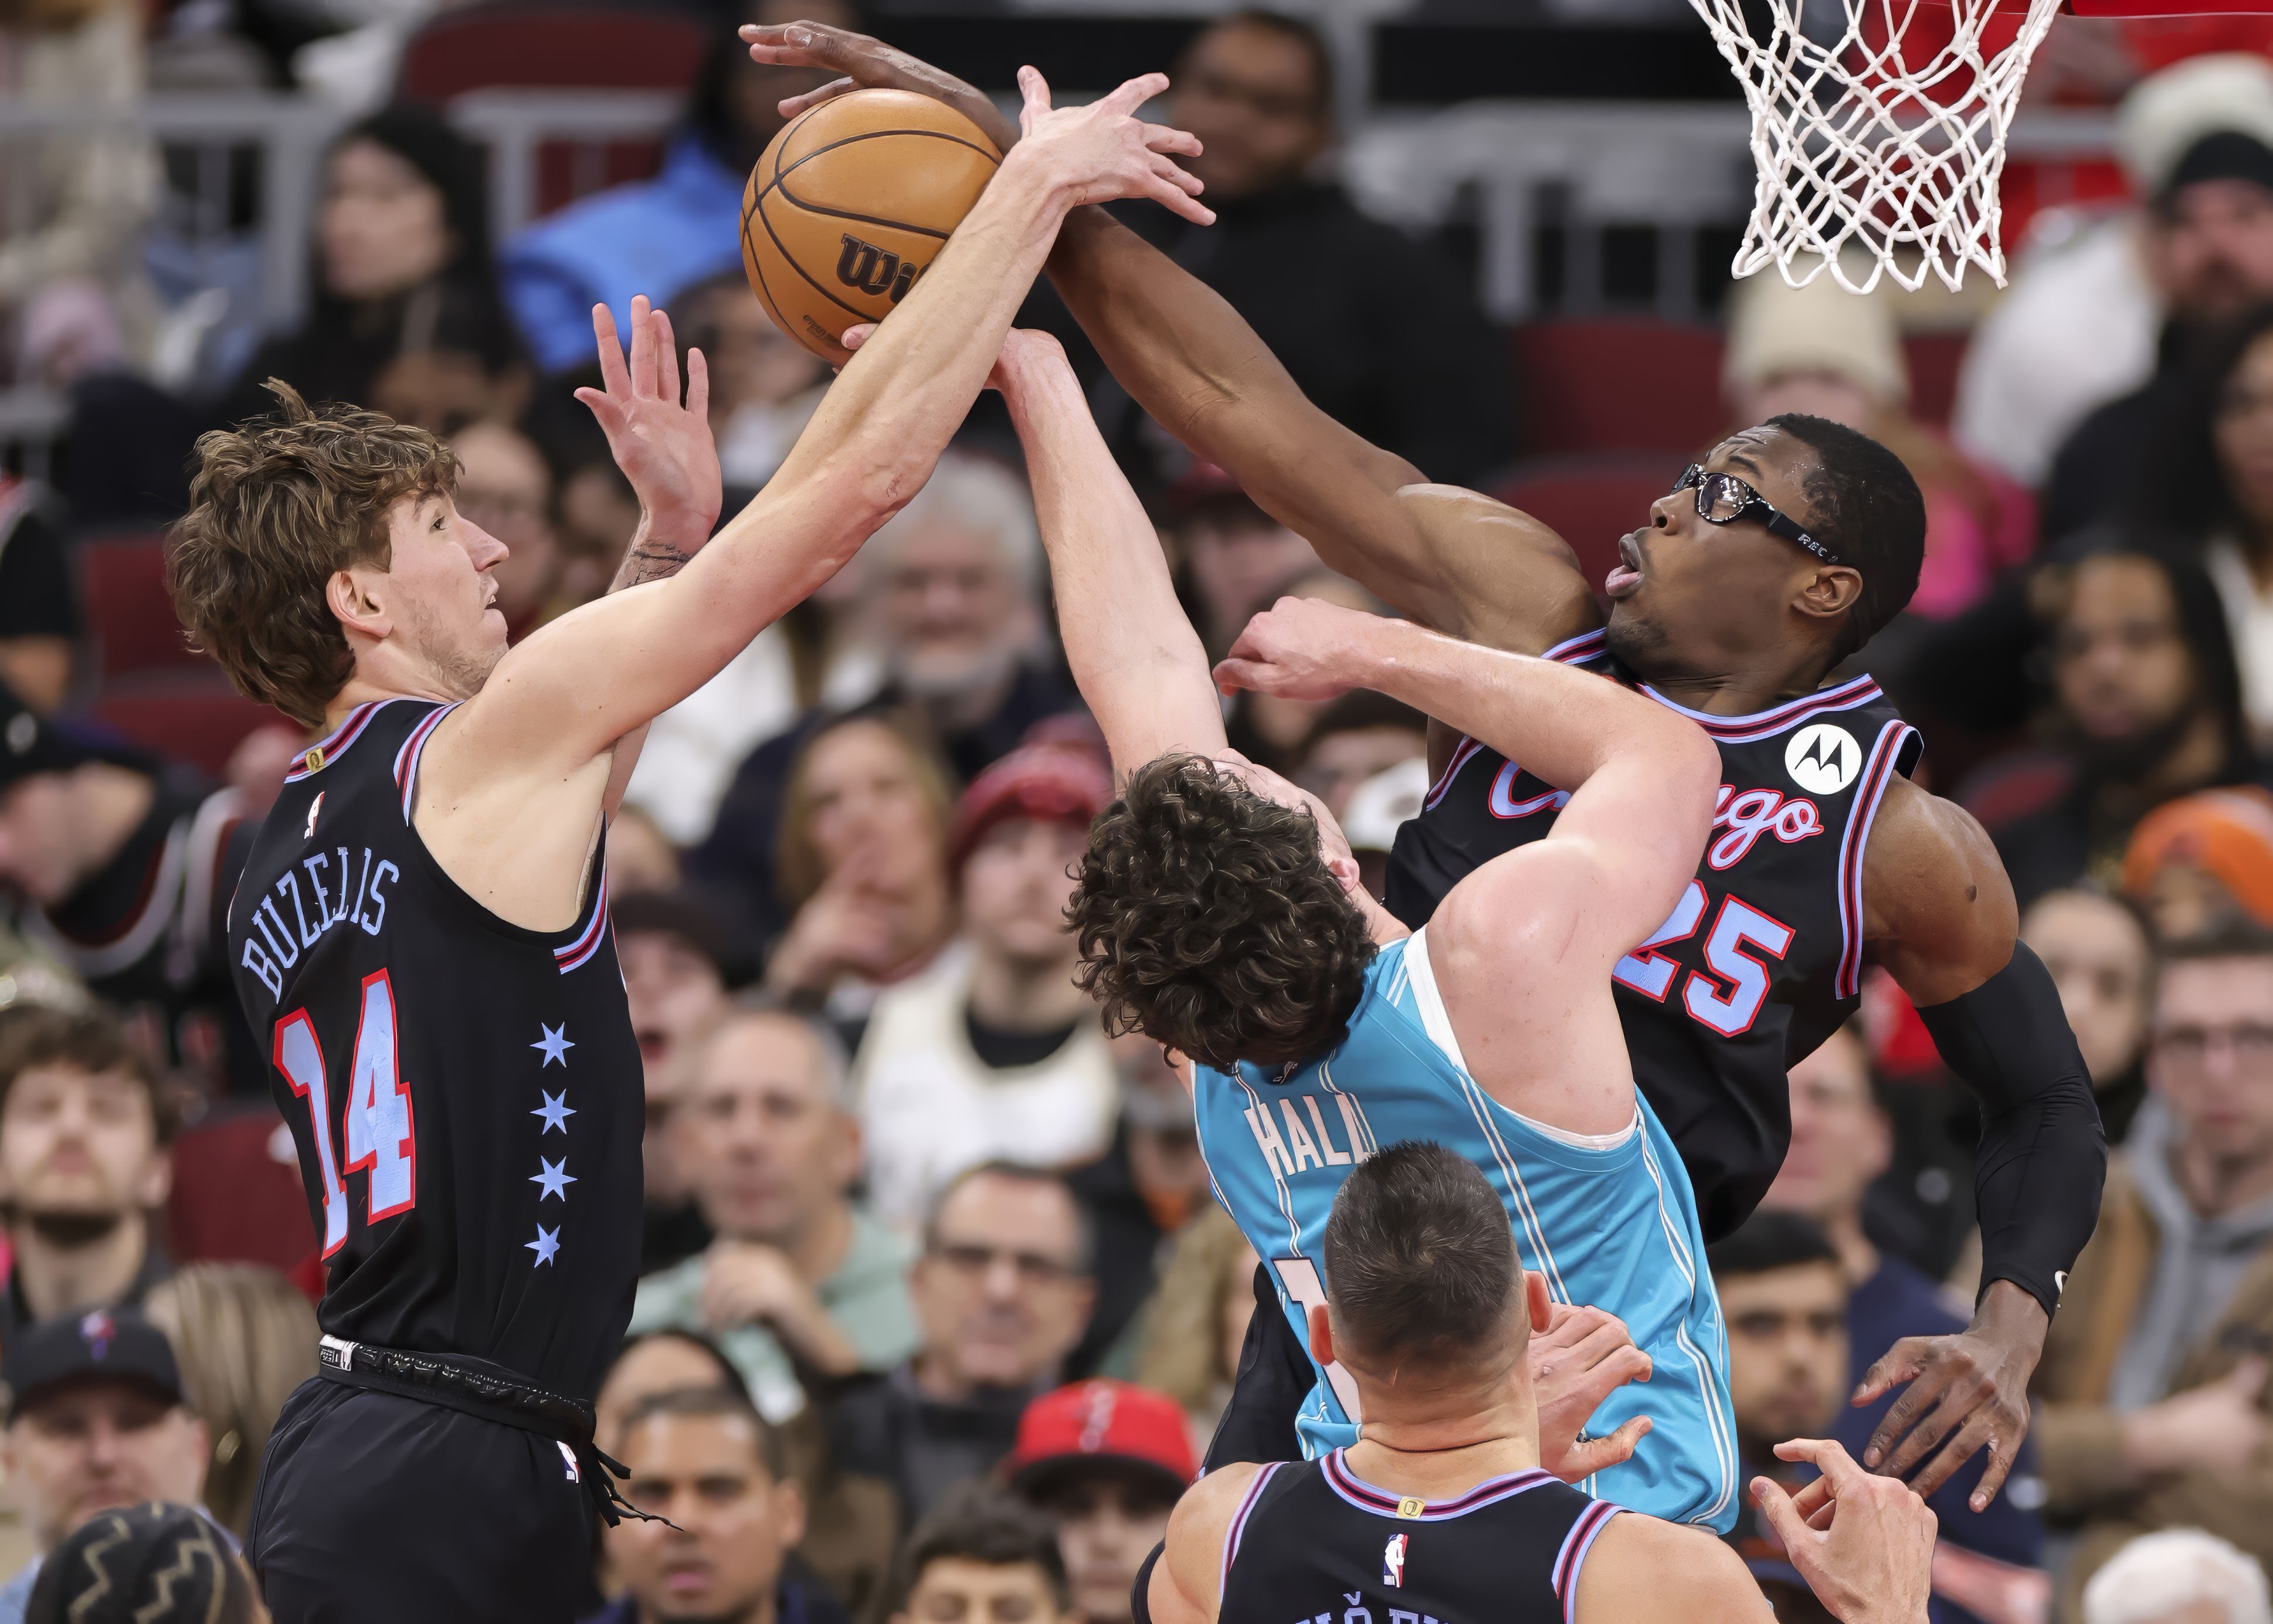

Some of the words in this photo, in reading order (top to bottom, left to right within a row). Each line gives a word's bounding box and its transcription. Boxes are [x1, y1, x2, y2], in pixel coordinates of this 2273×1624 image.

[836, 233, 929, 304] Wi
[242, 847, 399, 1005] BUZELIS
[1611, 878, 1796, 1038] 25
[273, 967, 416, 1262] 14
